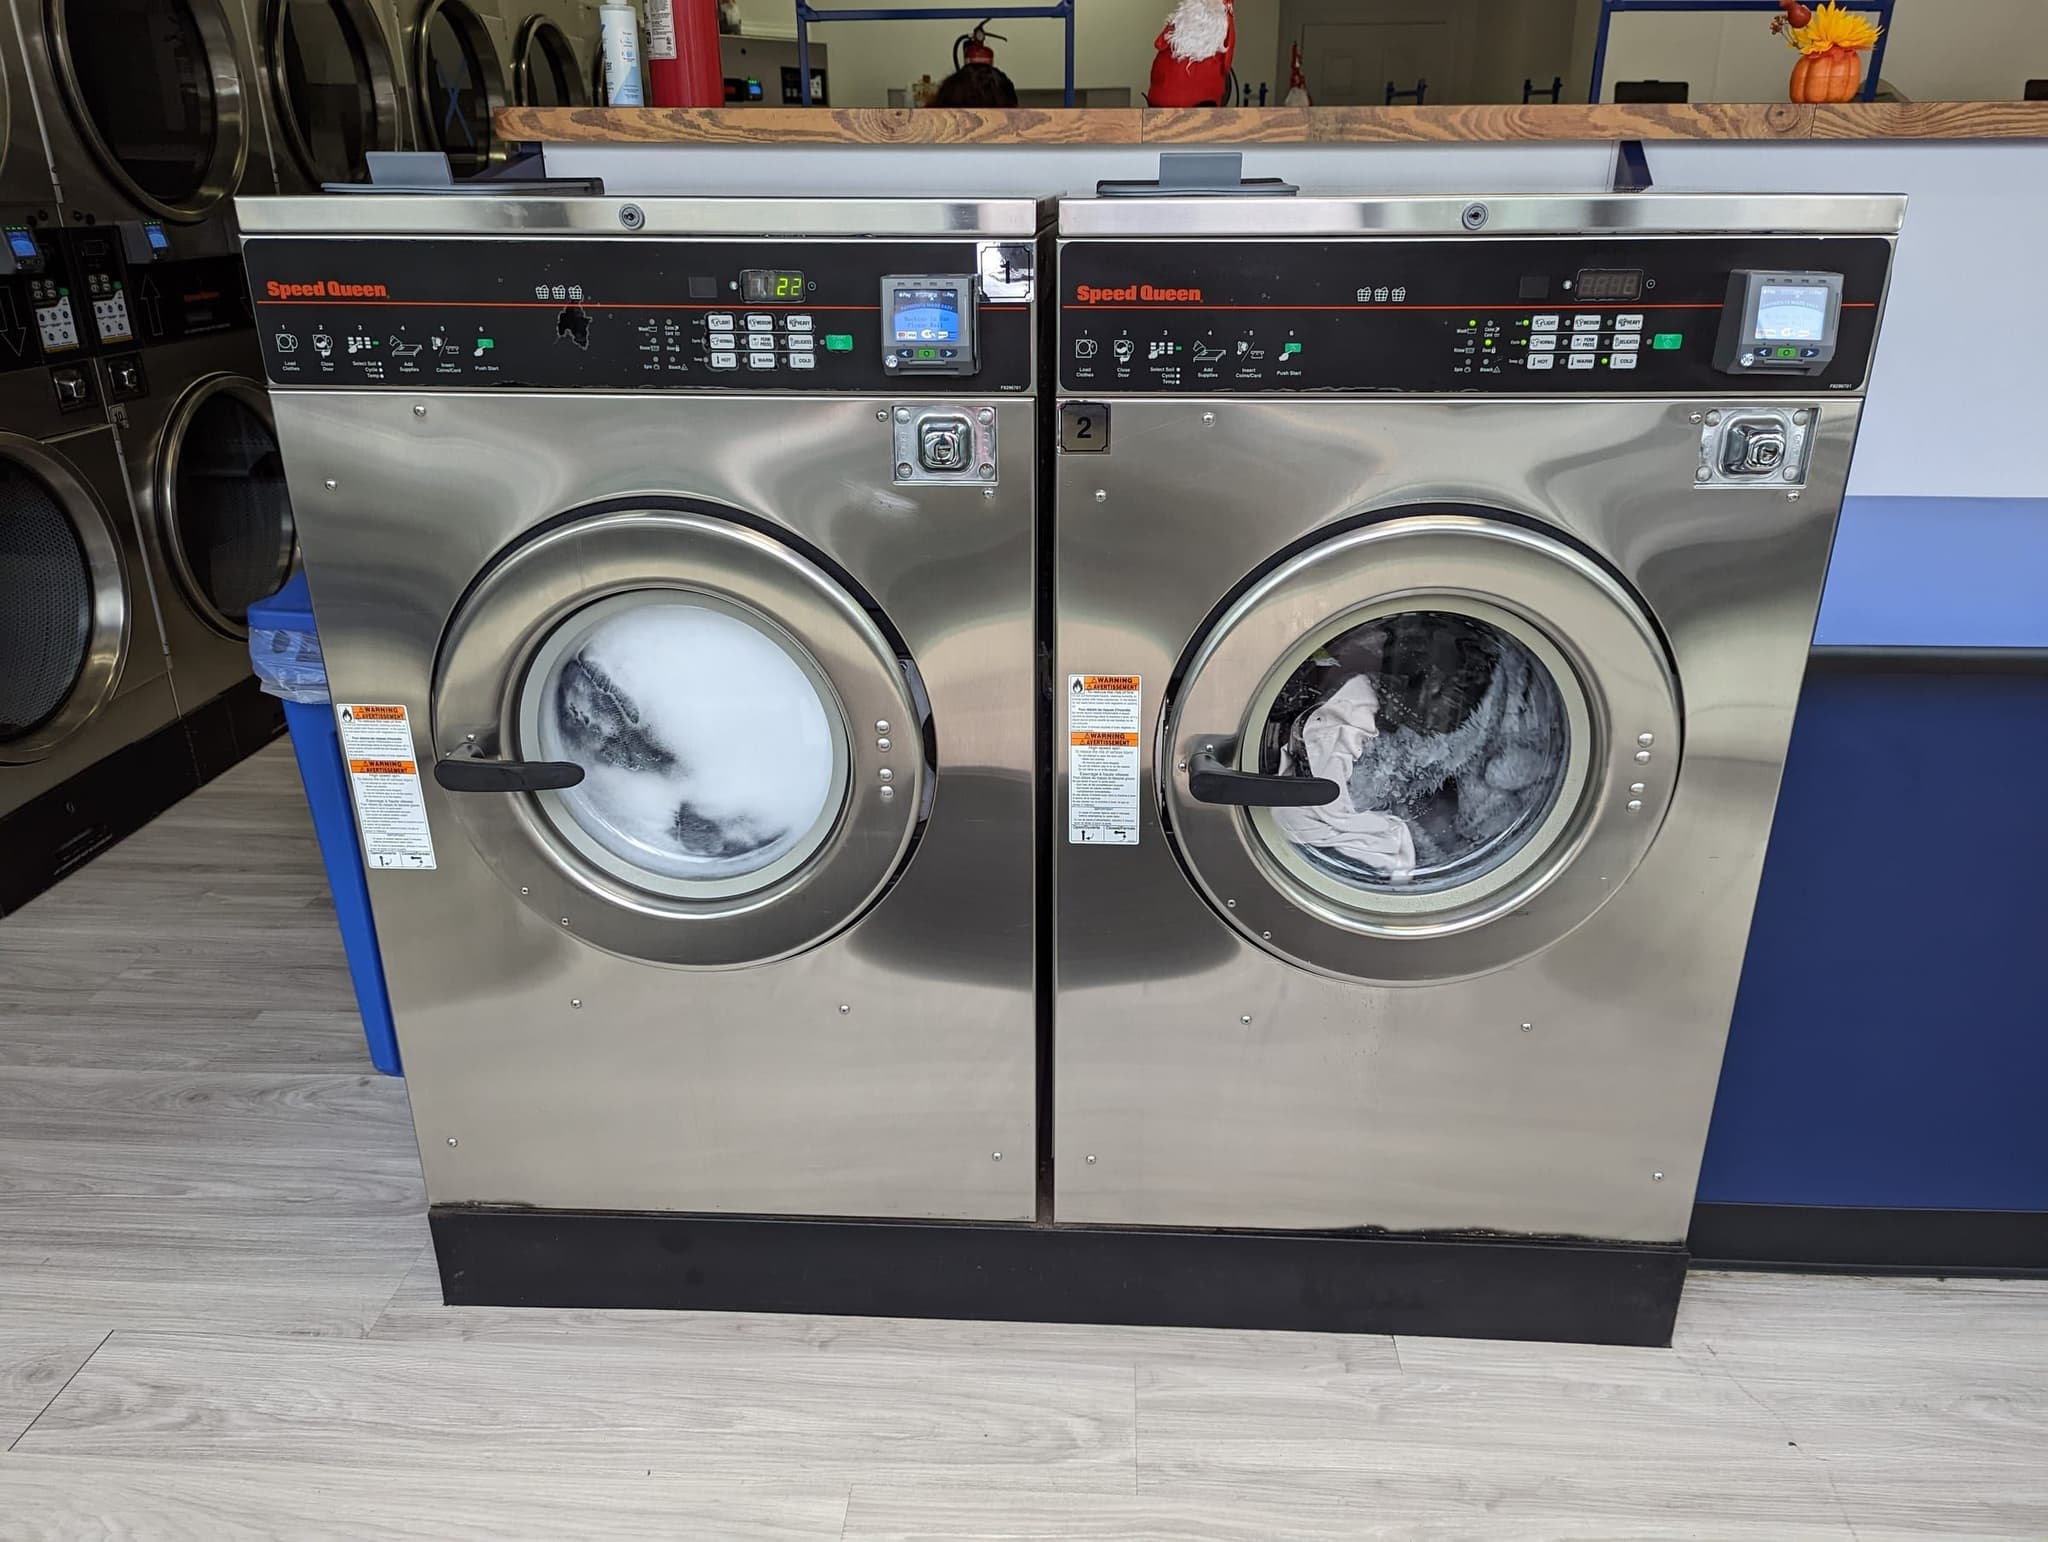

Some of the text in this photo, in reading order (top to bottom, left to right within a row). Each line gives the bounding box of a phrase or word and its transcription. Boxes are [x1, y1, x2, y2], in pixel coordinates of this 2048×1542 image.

[1000, 260, 1010, 284] 1
[267, 281, 387, 299] Speed Queen
[776, 277, 802, 296] 22
[1076, 285, 1201, 303] Speed Queen
[1077, 416, 1092, 438] 2
